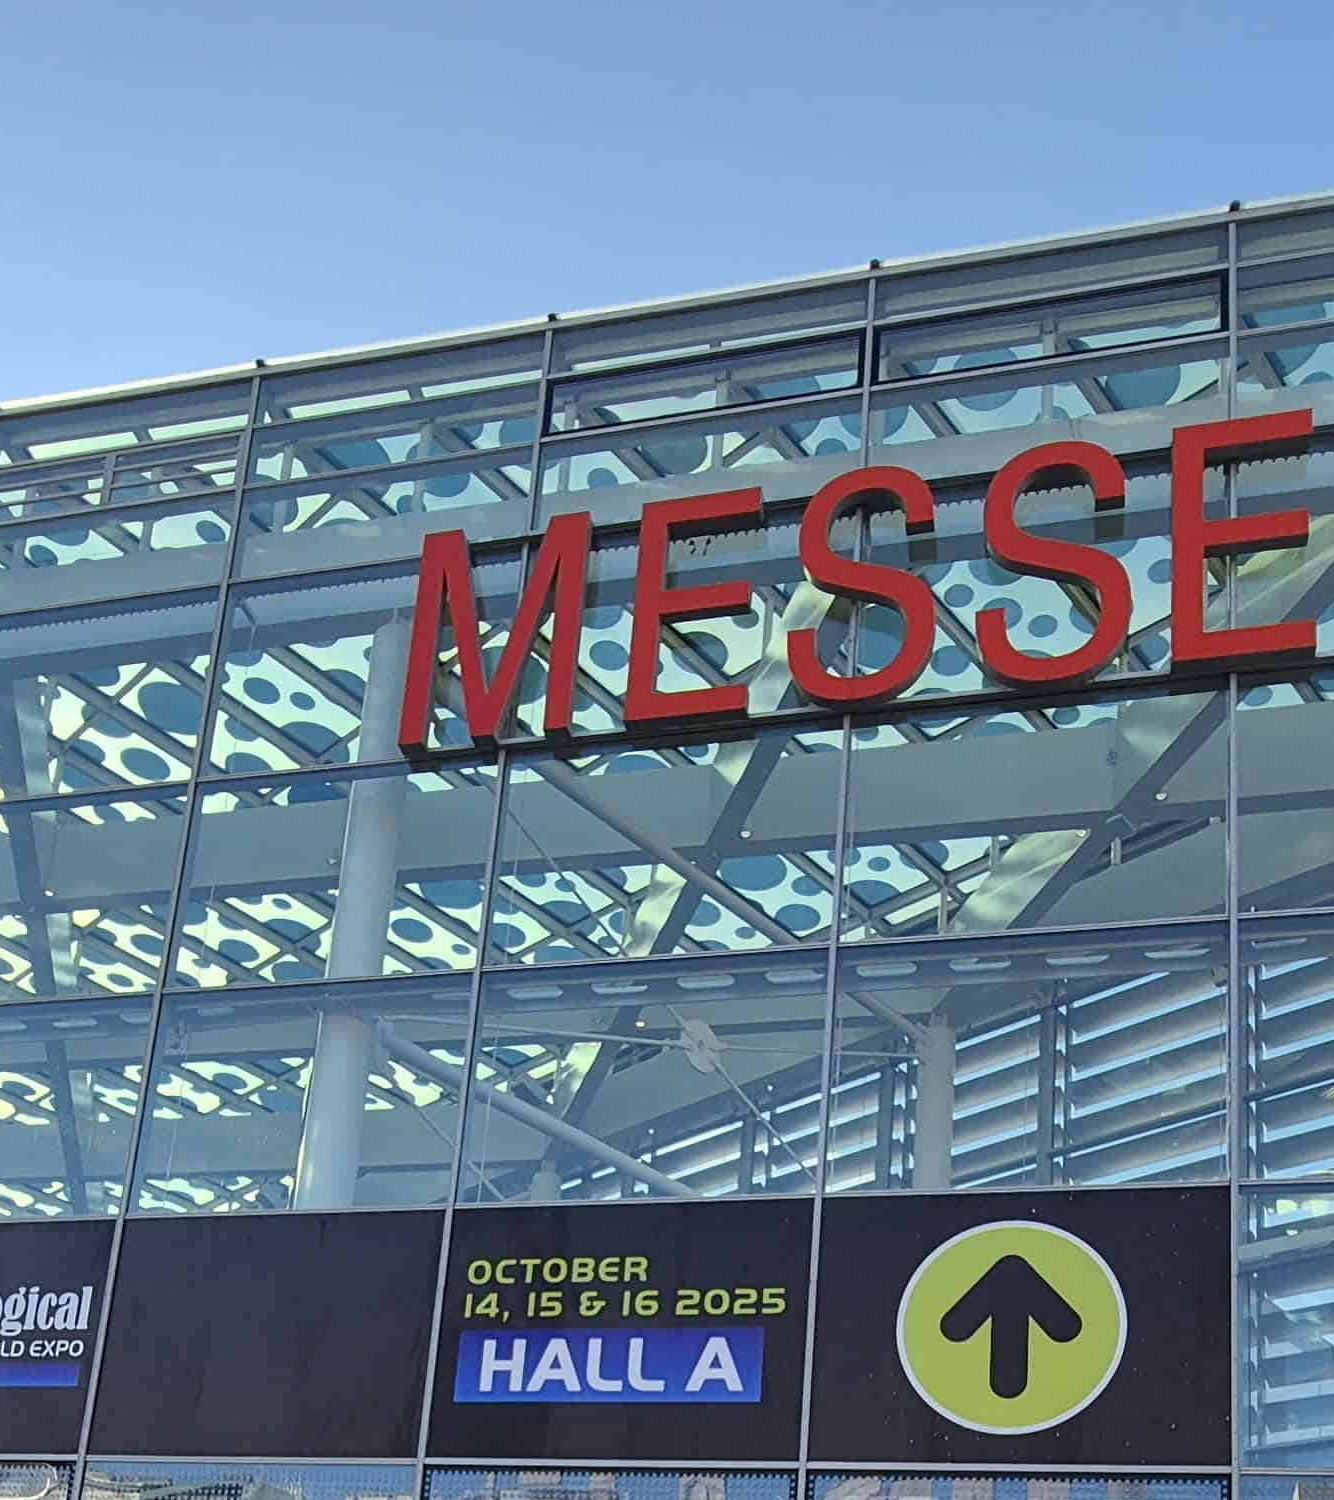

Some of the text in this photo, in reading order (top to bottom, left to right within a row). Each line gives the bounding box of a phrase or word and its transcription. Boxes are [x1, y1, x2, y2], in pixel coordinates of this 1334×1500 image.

[398, 408, 1319, 753] MESSE
[467, 1256, 650, 1286] OCTOBER
[463, 1287, 788, 1324] 14, 15 & 16 2025
[29, 1339, 85, 1358] EXPO
[479, 1335, 745, 1393] HALL A
